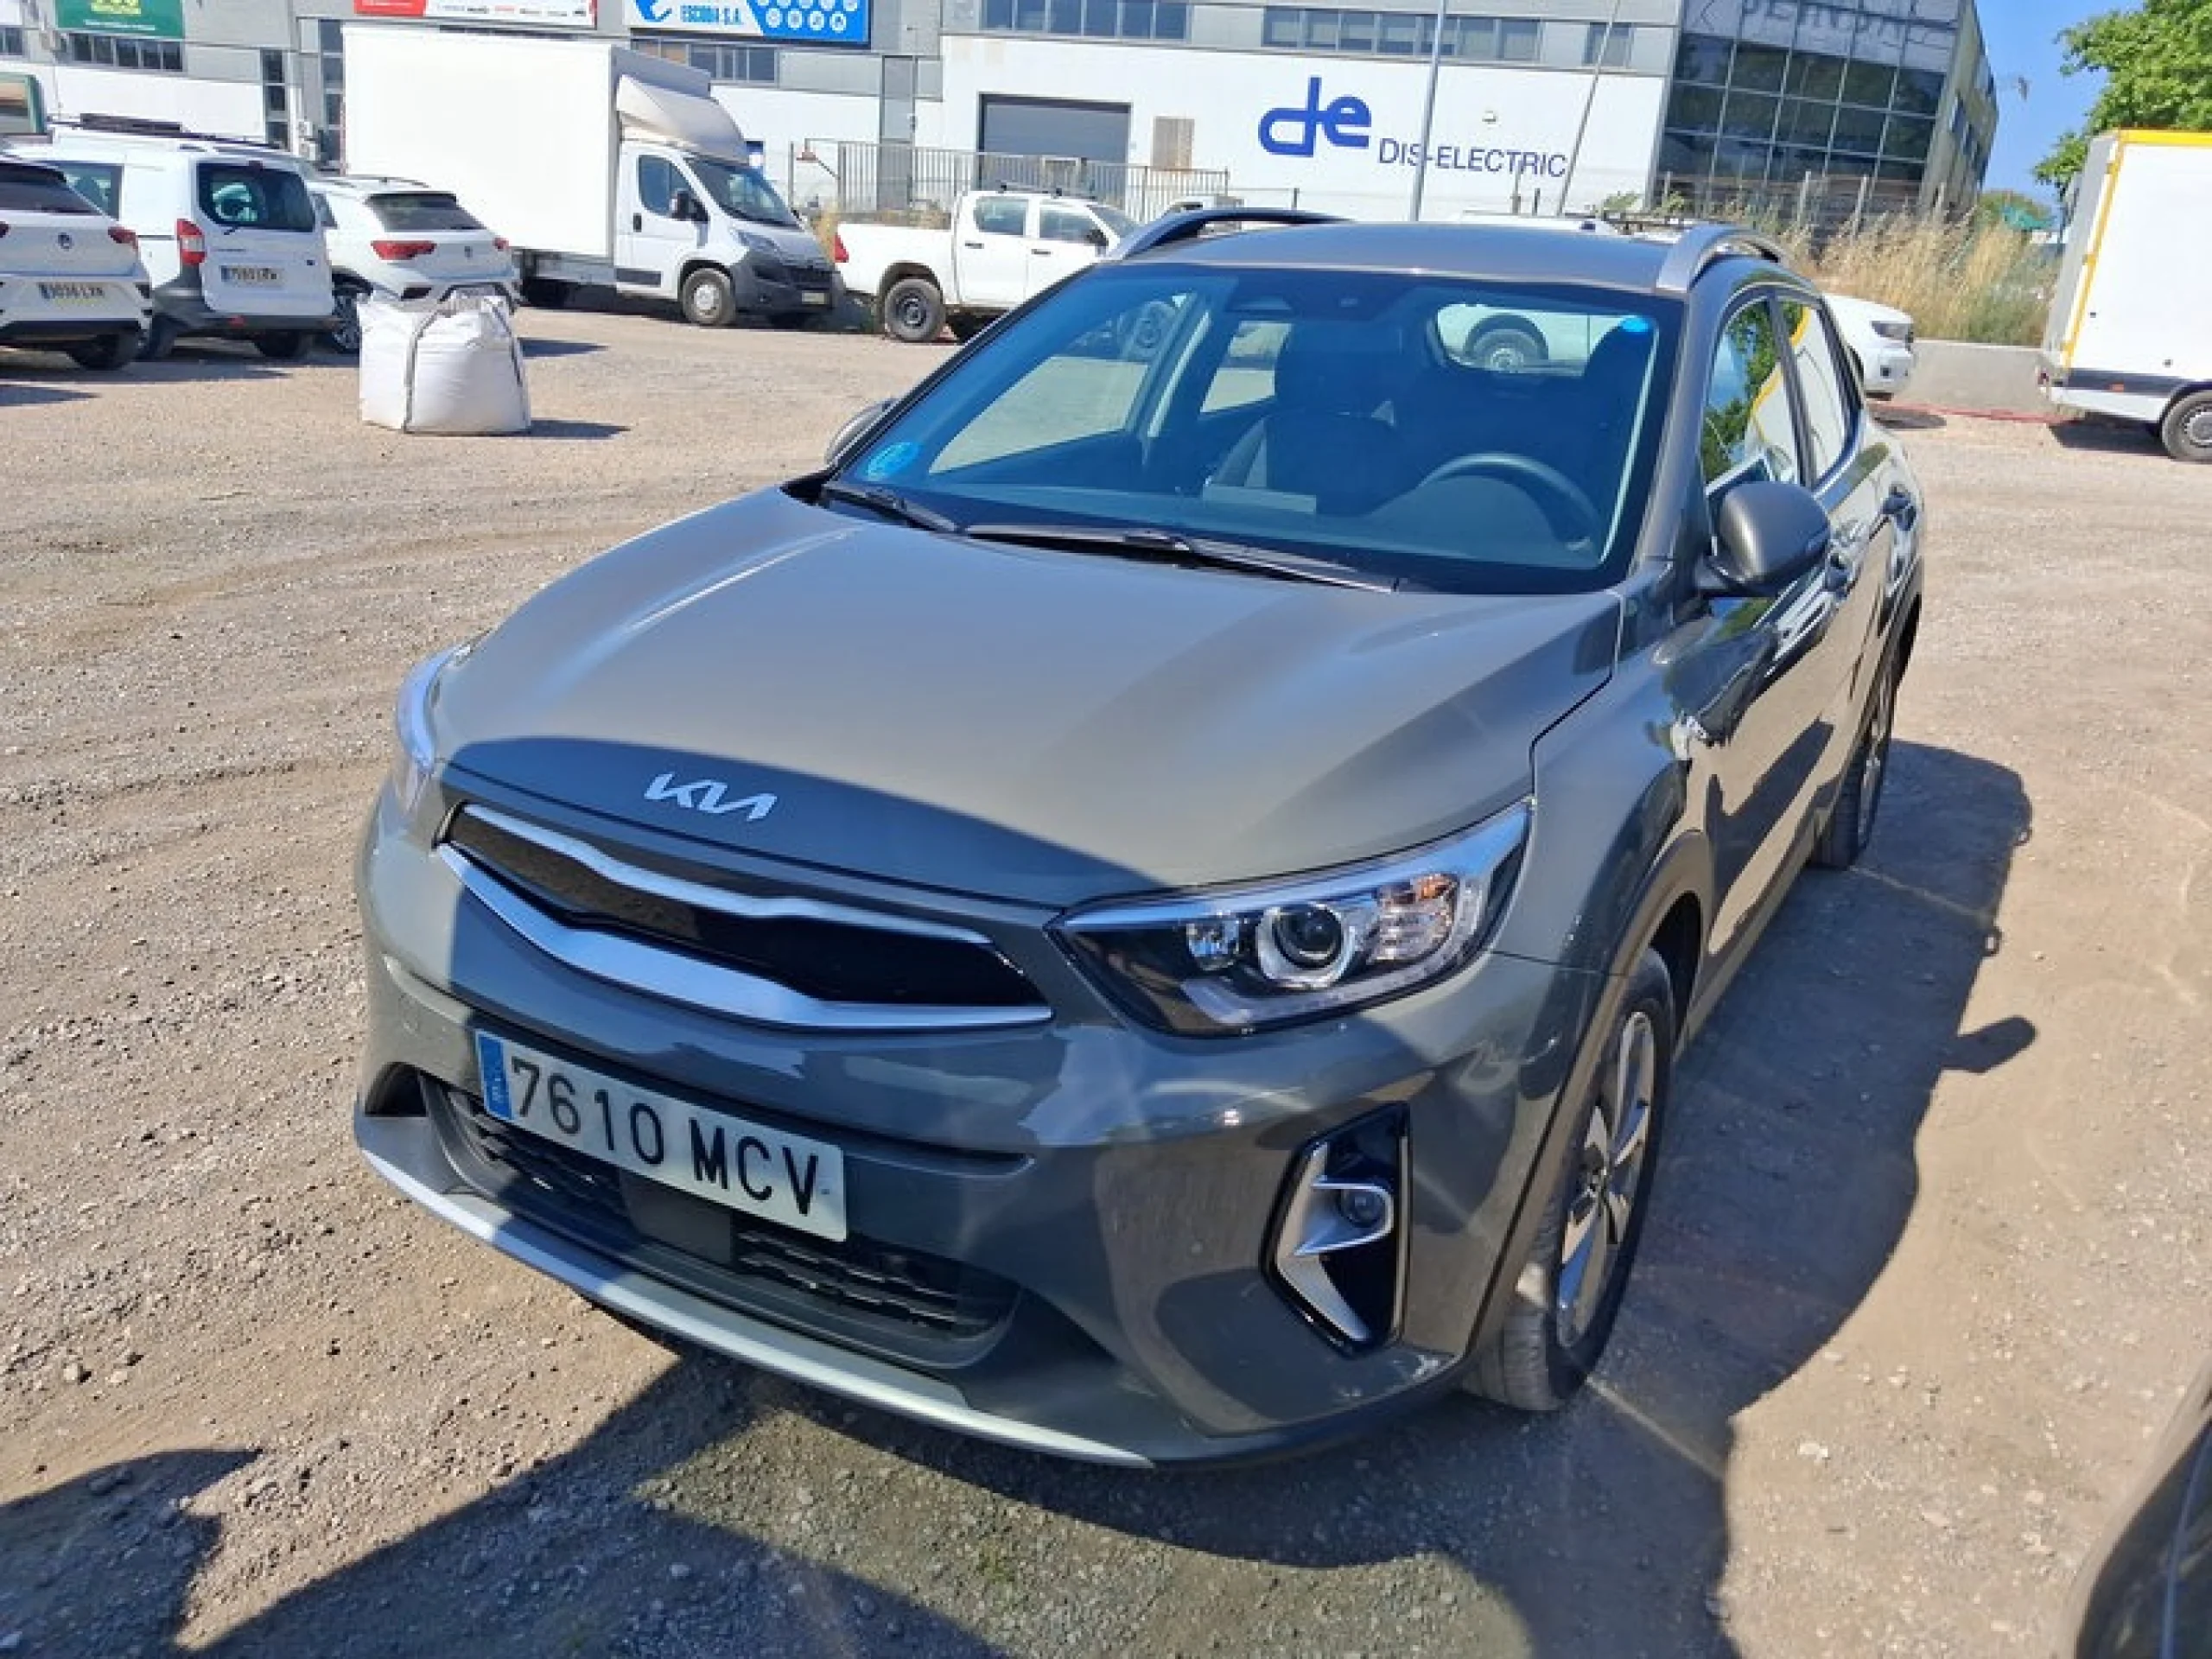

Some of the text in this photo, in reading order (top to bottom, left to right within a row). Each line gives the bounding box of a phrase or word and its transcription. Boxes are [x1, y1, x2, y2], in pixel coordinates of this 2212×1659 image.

[1257, 76, 1372, 158] de
[1378, 137, 1568, 179] DIS-ELECTRIC
[644, 772, 778, 822] KIA
[511, 1055, 819, 1217] 7610 MCV
